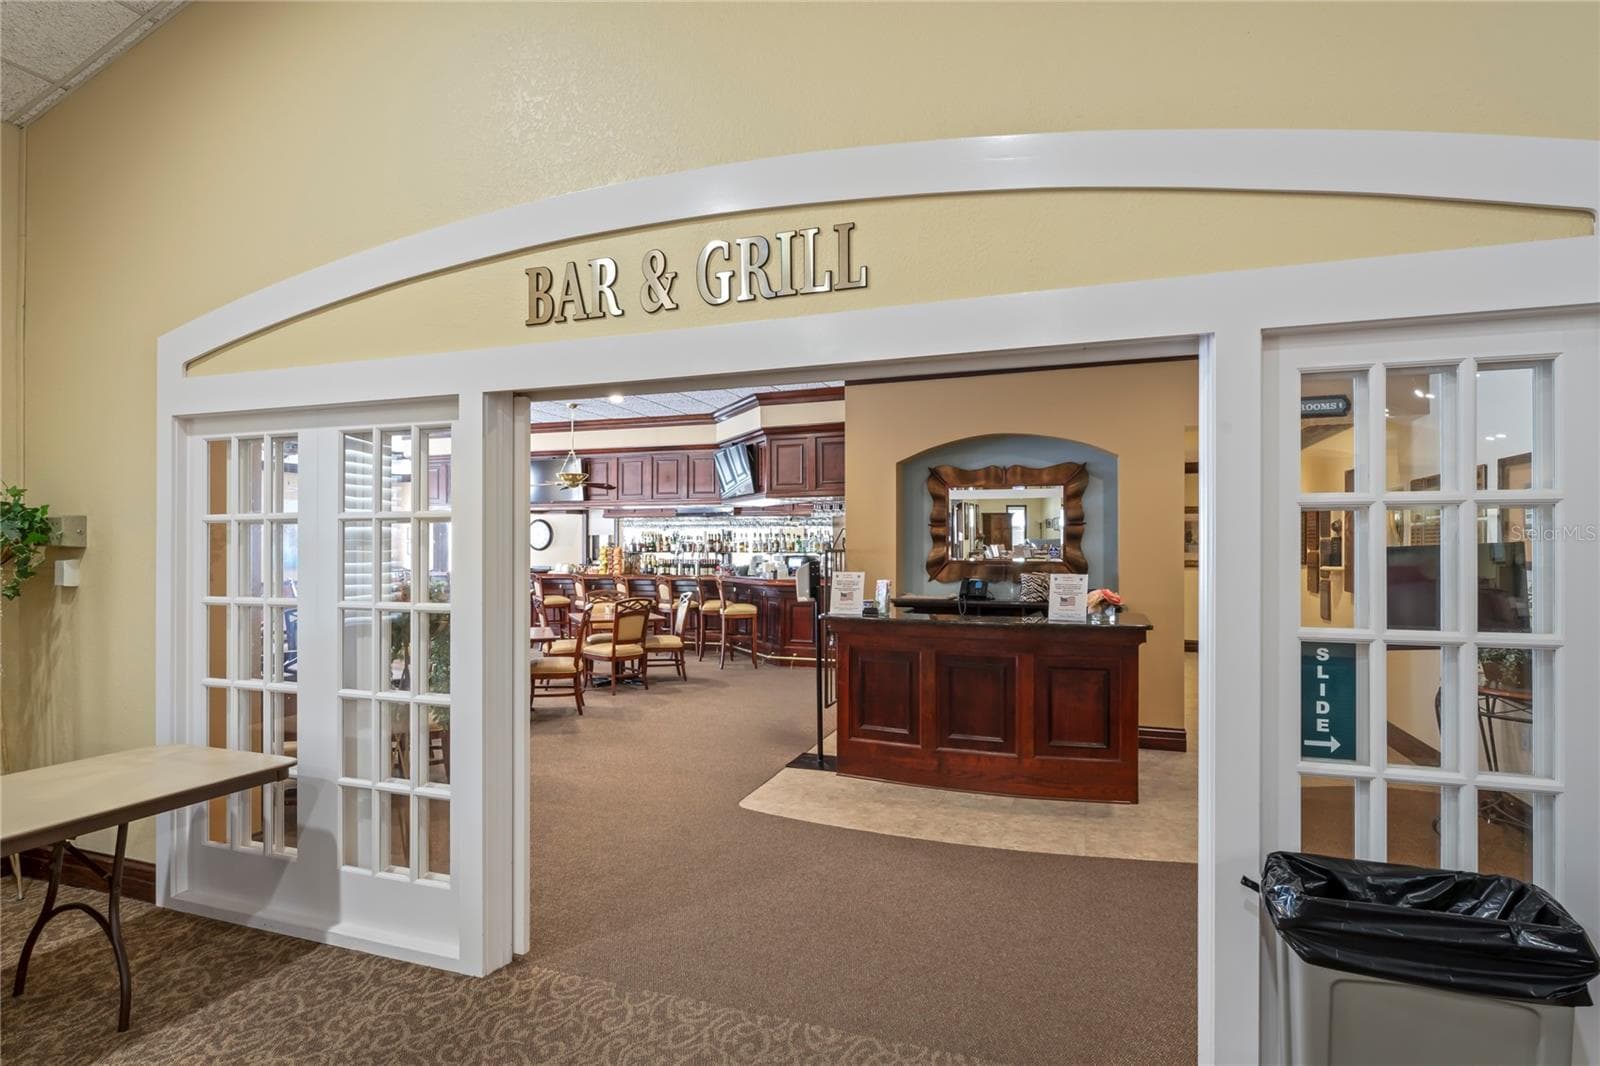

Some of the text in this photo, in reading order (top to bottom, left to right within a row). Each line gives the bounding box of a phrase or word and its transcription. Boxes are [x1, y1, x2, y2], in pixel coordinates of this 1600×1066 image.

[525, 222, 868, 327] BAR & GRILL
[1315, 647, 1331, 732] SLIDE
